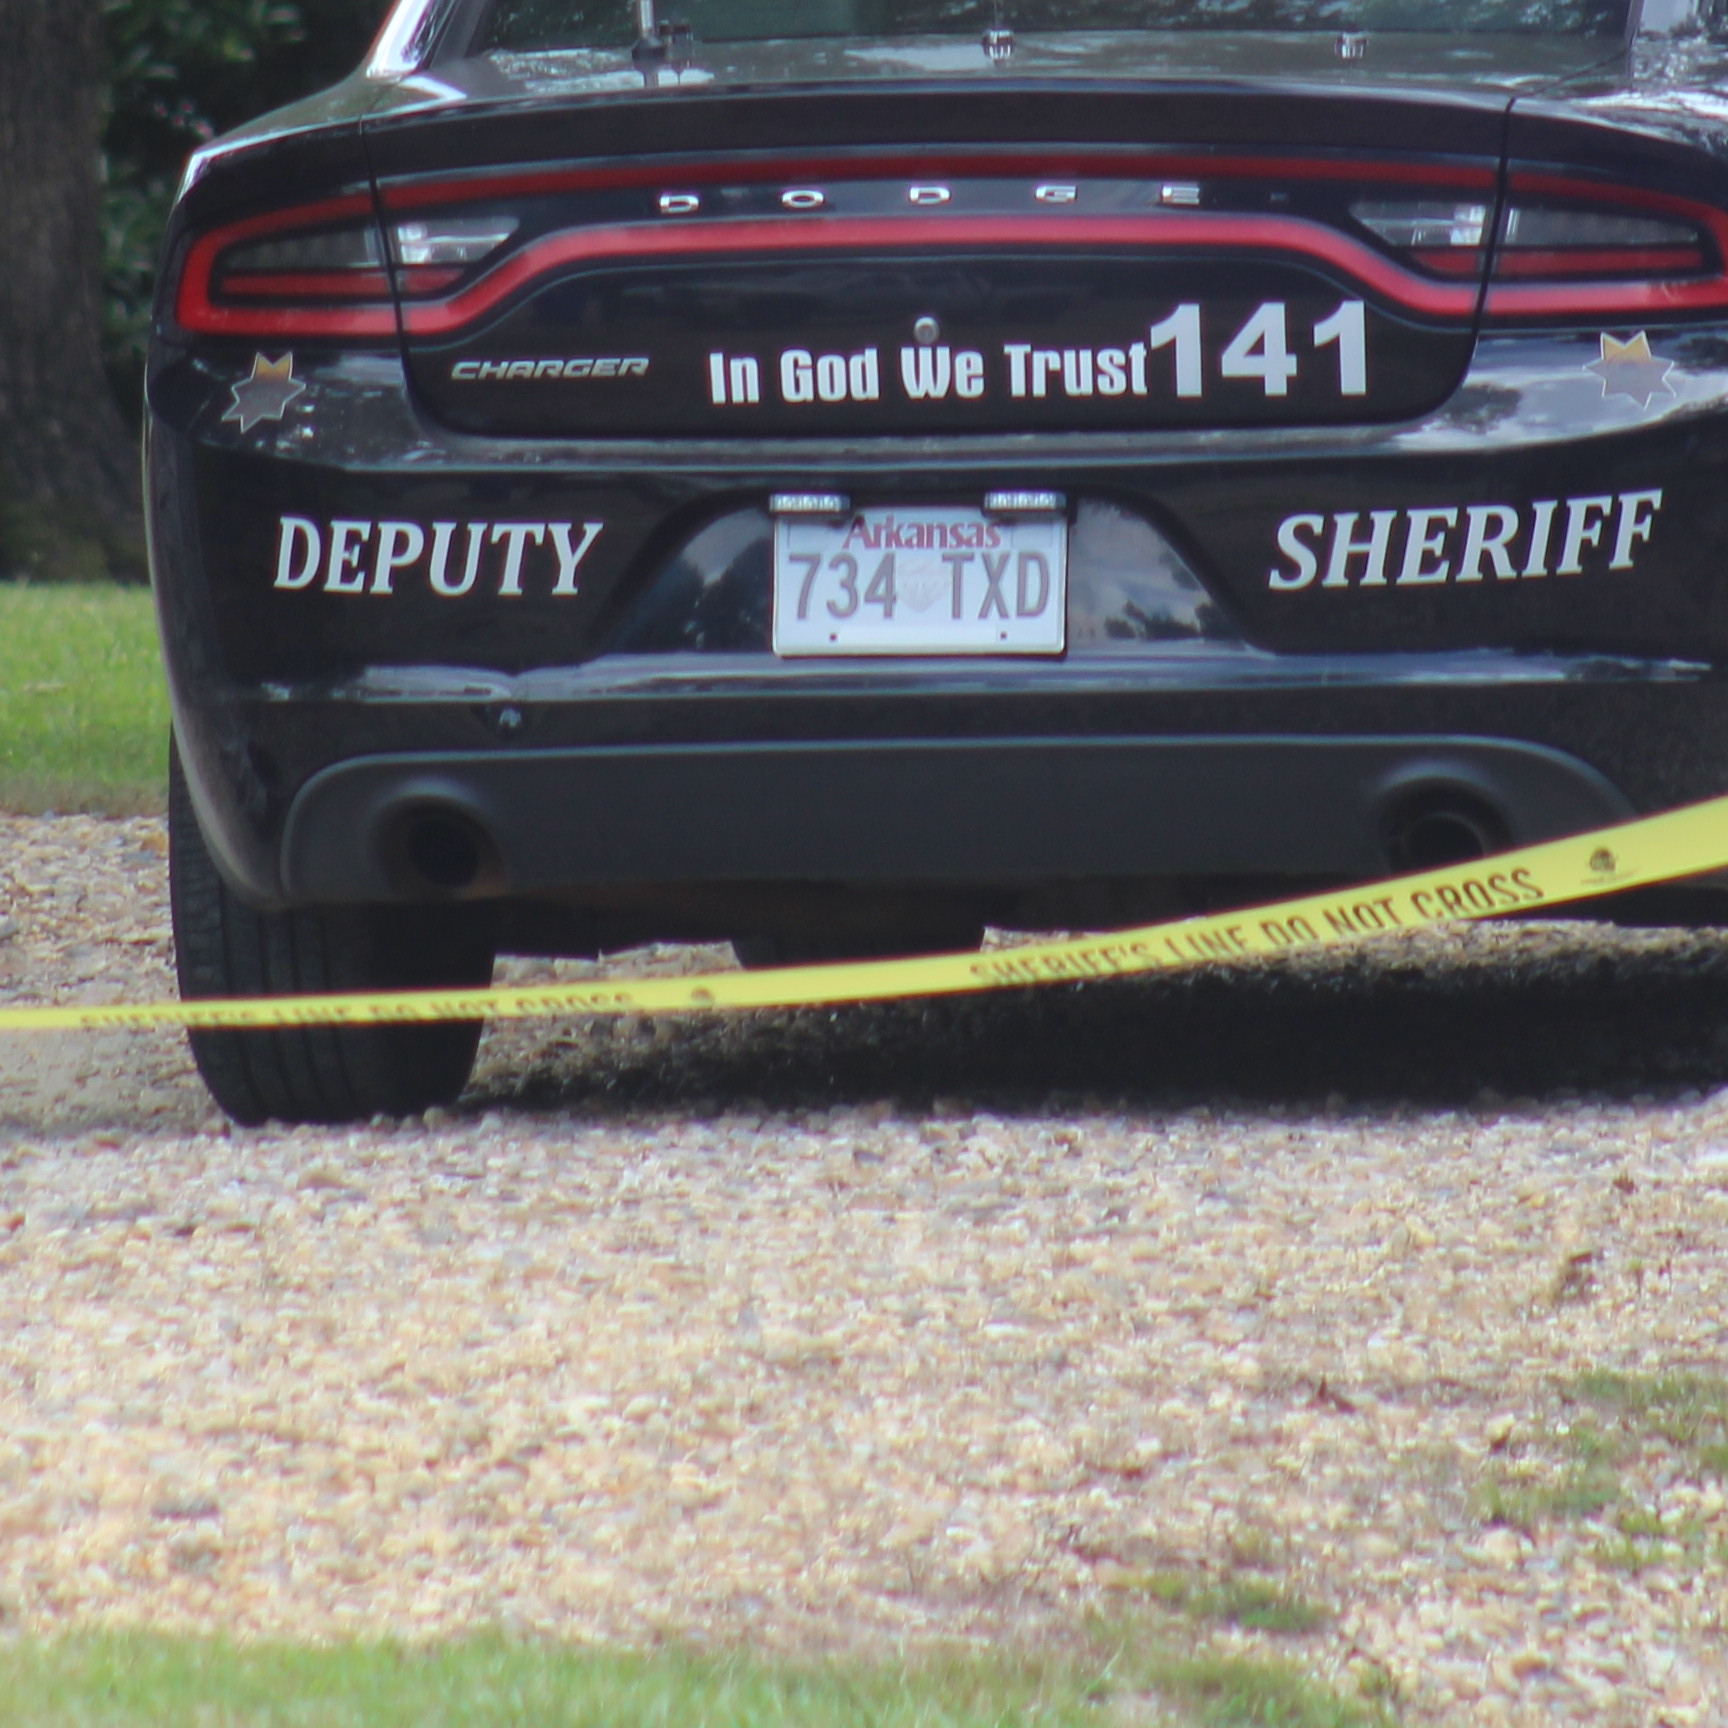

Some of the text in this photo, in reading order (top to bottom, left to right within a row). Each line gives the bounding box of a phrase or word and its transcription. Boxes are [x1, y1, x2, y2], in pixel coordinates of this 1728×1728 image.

[659, 183, 1200, 213] DODGE
[451, 357, 650, 380] CHARGER
[709, 342, 1147, 403] In God We Trust
[1150, 300, 1368, 398] 141
[273, 516, 604, 596] DEPUTY
[842, 513, 1001, 550] Arkansas
[1269, 488, 1663, 591] SHERIFF
[788, 551, 1050, 620] 734 TXD
[1322, 897, 1403, 936] NOT
[1409, 867, 1545, 920] CROSS
